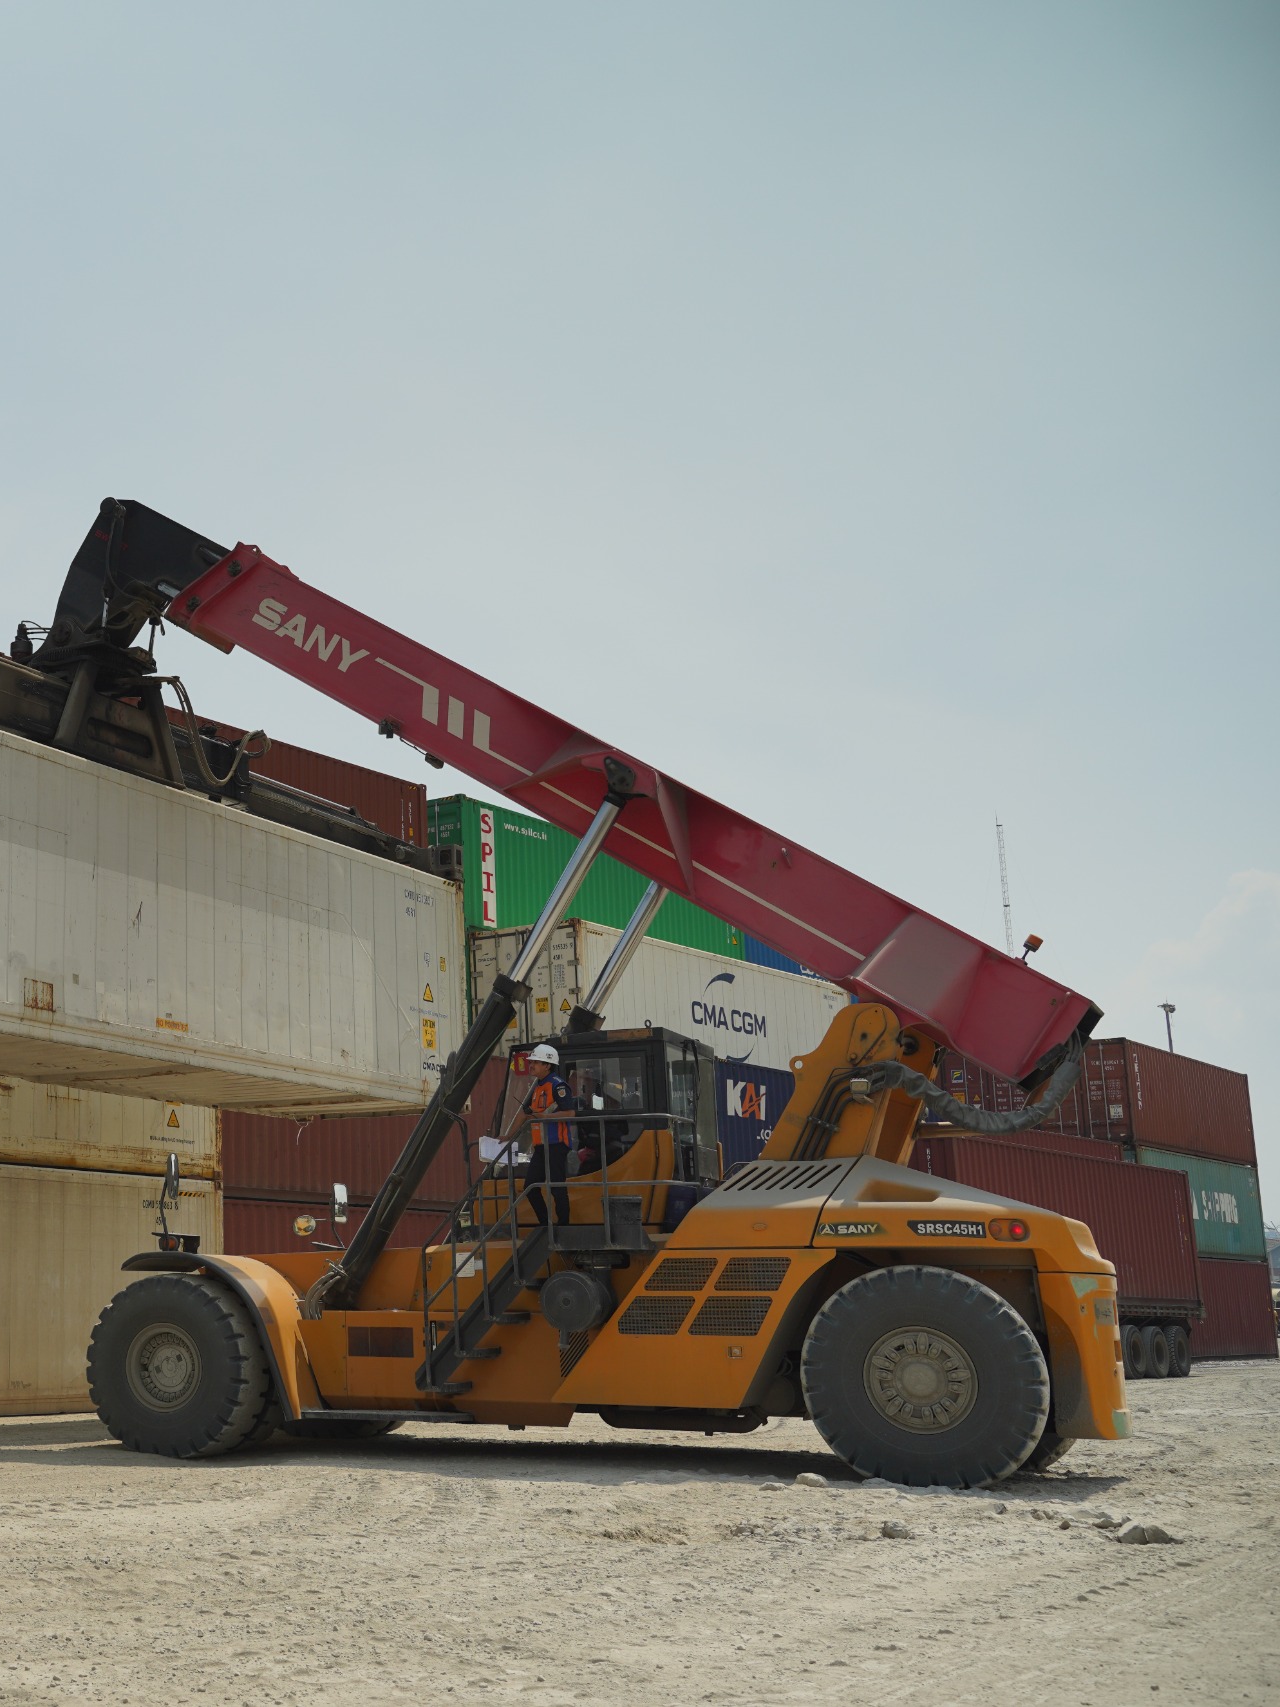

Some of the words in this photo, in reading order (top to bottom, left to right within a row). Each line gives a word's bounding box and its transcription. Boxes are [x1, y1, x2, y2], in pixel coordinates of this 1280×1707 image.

[252, 598, 370, 673] SANY
[480, 814, 494, 922] SPIL
[692, 1001, 729, 1030] CMA
[731, 1010, 766, 1037] CGM
[727, 1079, 766, 1120] KAI
[837, 1223, 878, 1234] SANY
[917, 1223, 984, 1236] SRSC45H1
